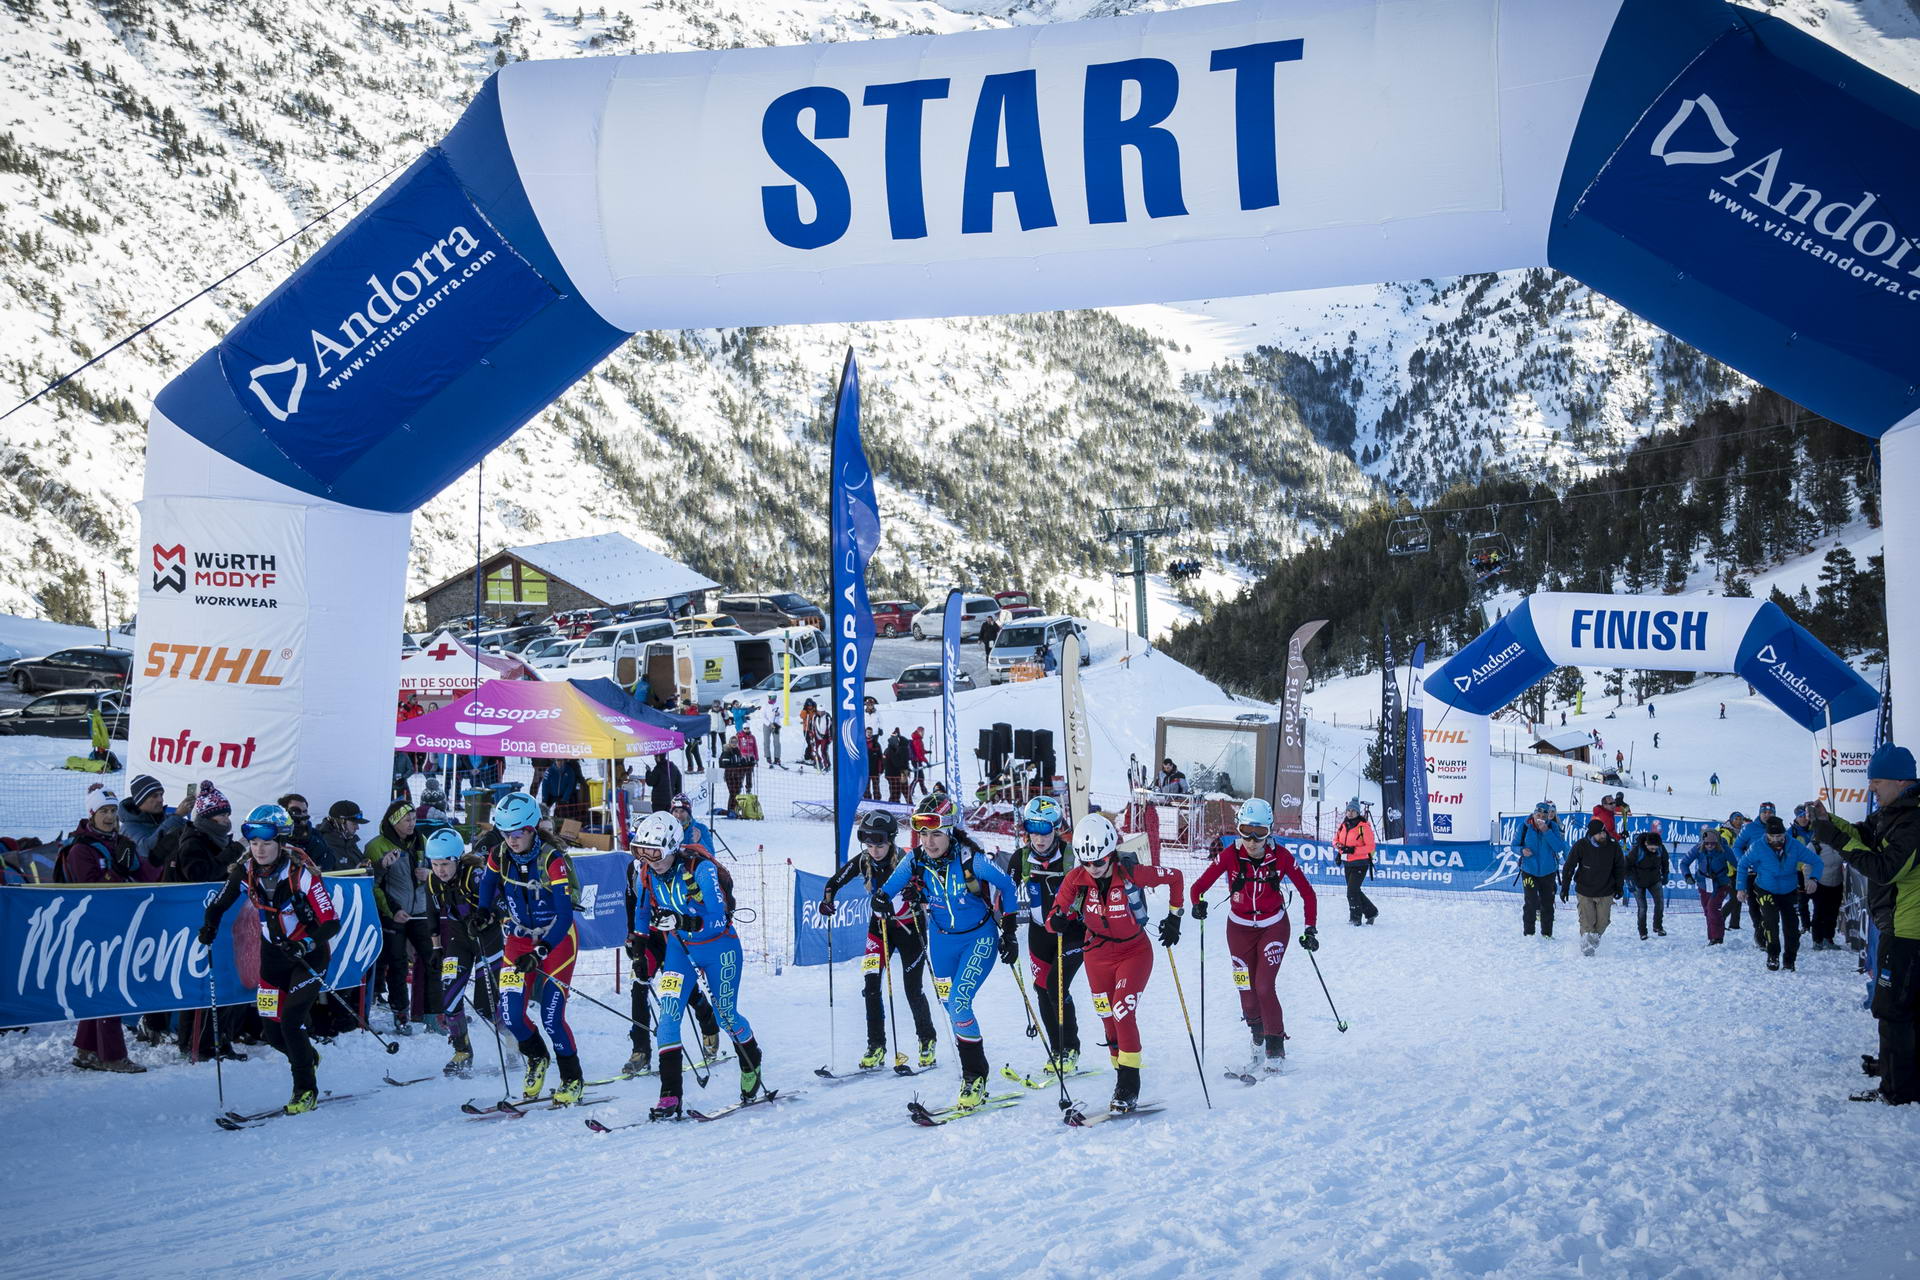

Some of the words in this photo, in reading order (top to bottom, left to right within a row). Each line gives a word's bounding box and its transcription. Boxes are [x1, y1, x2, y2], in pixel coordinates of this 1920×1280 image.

[761, 38, 1304, 250] START
[311, 225, 480, 378] Andorra
[327, 249, 496, 391] www.visitandorra.com
[194, 552, 276, 571] WÜRTH
[194, 571, 277, 588] MODYF
[195, 595, 278, 609] WORKWEAR
[1571, 609, 1708, 651] FINISH
[1471, 642, 1521, 682] Andorra
[420, 678, 436, 687] DE
[439, 677, 485, 688] SOCORS
[1771, 661, 1827, 708] Andorra
[463, 701, 563, 723] Gasopas
[149, 729, 256, 769] infront
[415, 734, 472, 751] Gasopas
[500, 738, 536, 752] Bona
[1427, 791, 1463, 804] nfront
[1434, 825, 1451, 833] ISMF
[1285, 843, 1339, 861] FON
[708, 867, 723, 904] ITALIA
[311, 881, 333, 914] FRANCE
[17, 893, 213, 1021] Marlene
[443, 964, 454, 972] 59
[502, 974, 520, 984] 253
[661, 978, 678, 990] 251
[937, 984, 949, 994] 52
[546, 991, 560, 1028] Andorra
[1094, 1000, 1106, 1009] 54
